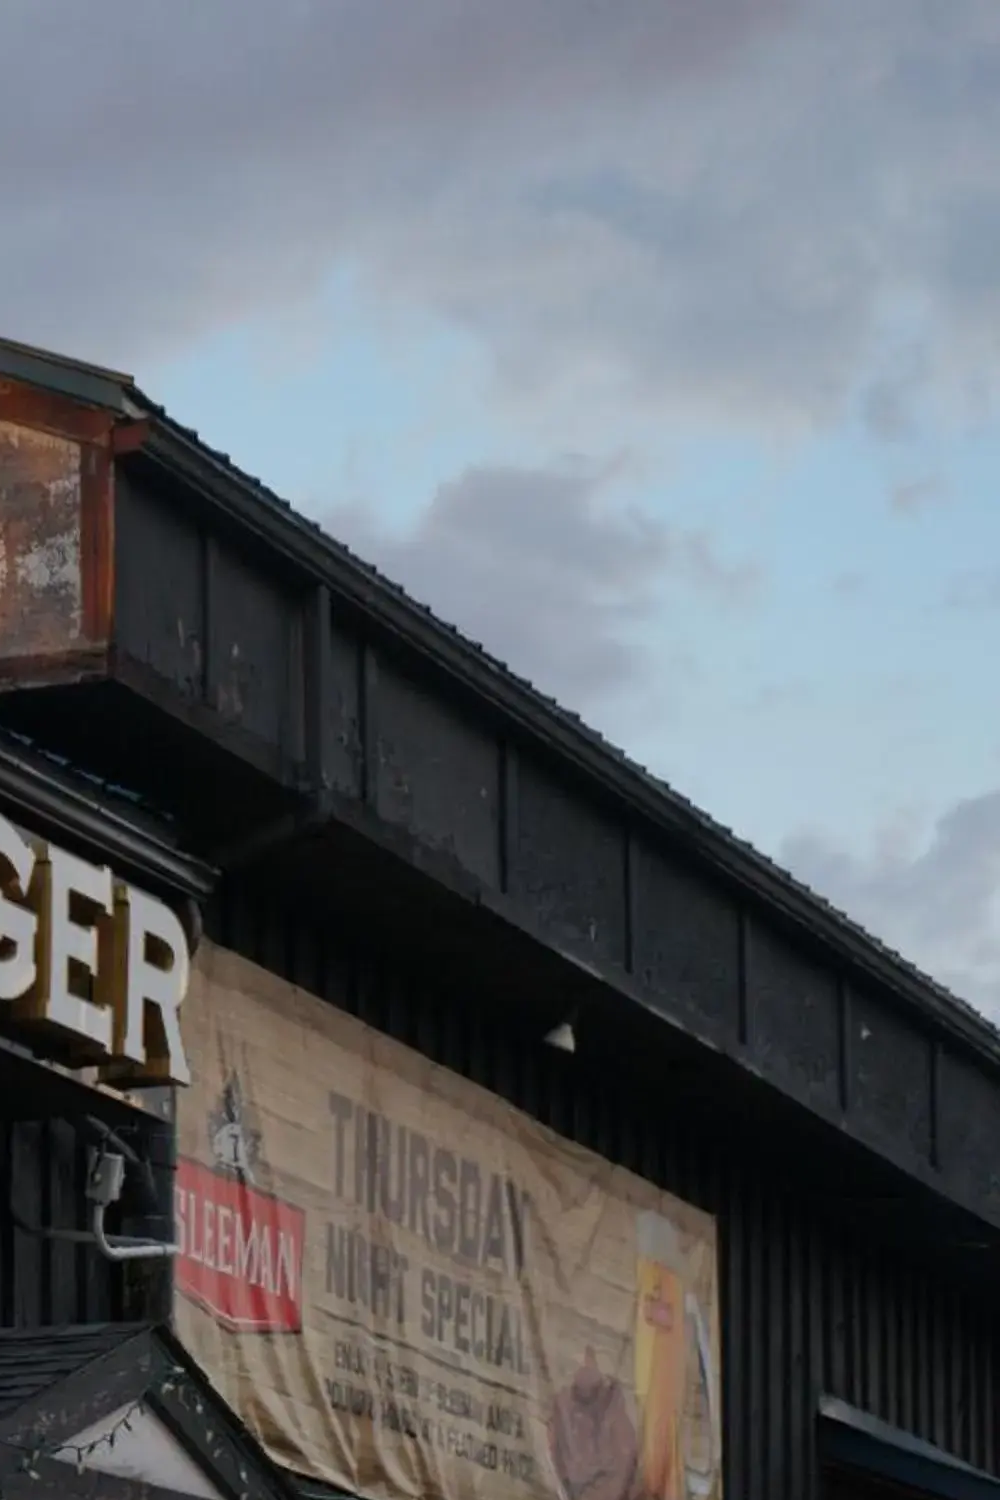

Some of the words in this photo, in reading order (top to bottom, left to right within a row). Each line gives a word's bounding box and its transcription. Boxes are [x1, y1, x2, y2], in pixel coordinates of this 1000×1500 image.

[327, 1090, 536, 1281] THURSDAY
[175, 1186, 297, 1301] SLEEMAN
[420, 1268, 531, 1375] SPECIAL
